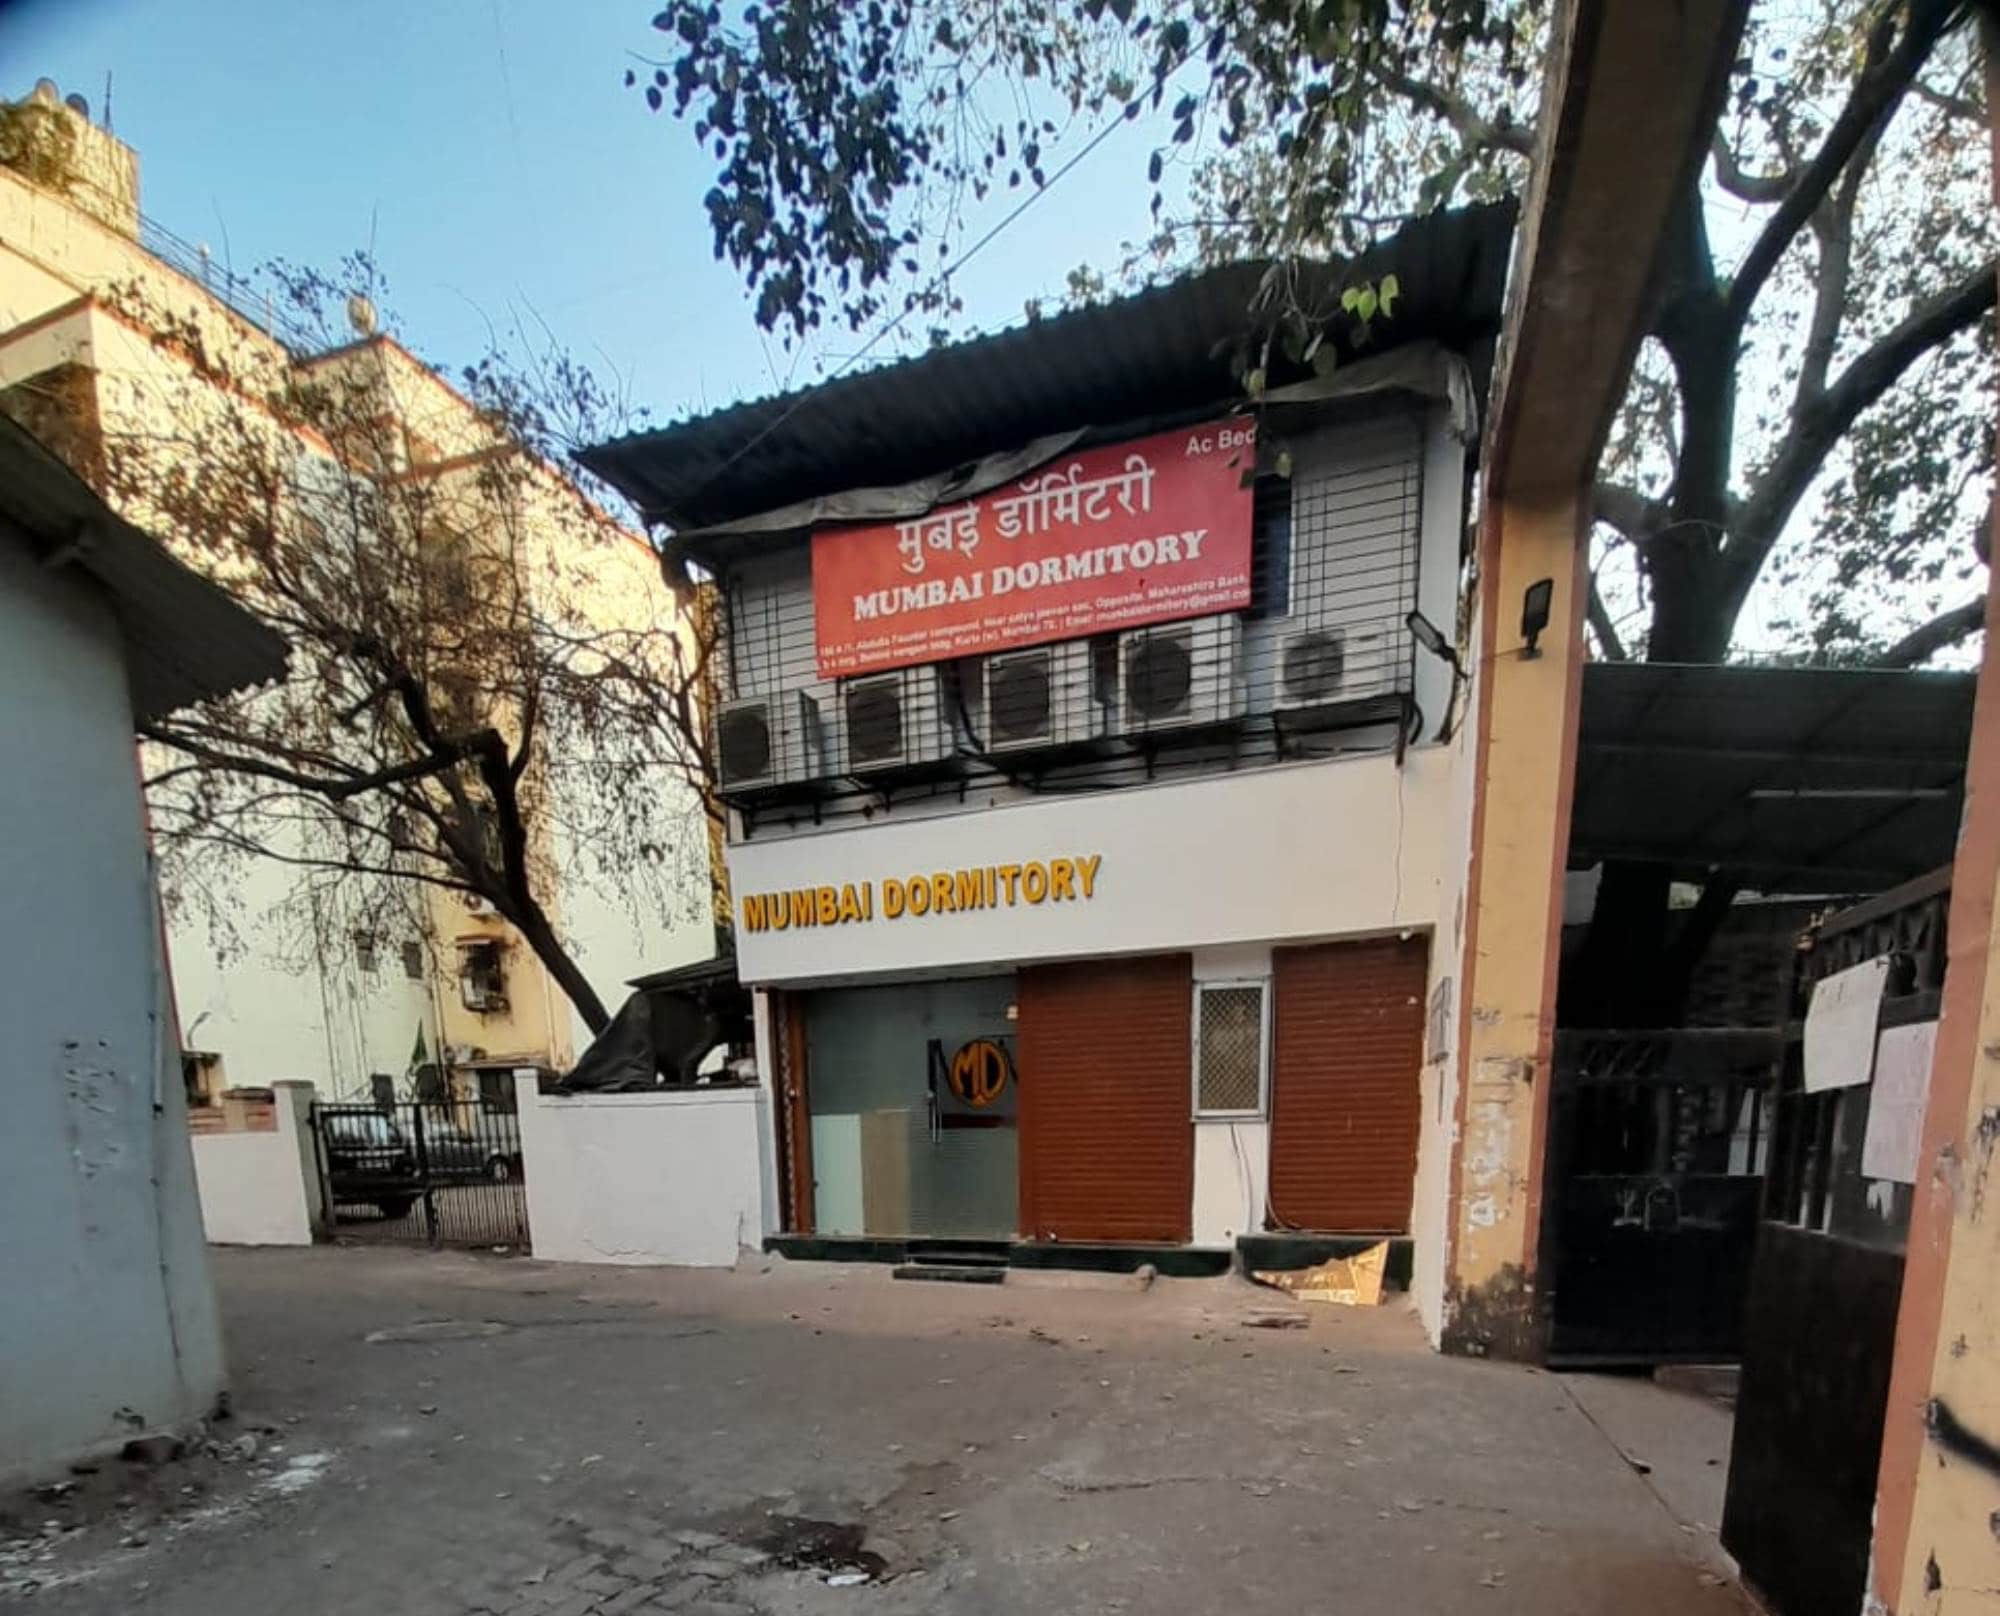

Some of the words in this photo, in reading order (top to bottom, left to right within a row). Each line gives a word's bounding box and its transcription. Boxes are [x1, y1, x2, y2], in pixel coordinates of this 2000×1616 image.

[1185, 435, 1213, 456] Ac
[992, 453, 1156, 539] डॉर्मिटरी
[853, 573, 984, 622] MUMBAI
[992, 529, 1209, 597] DORMITORY
[743, 881, 872, 934] MUMBAI
[882, 854, 1102, 920] DORMITORY
